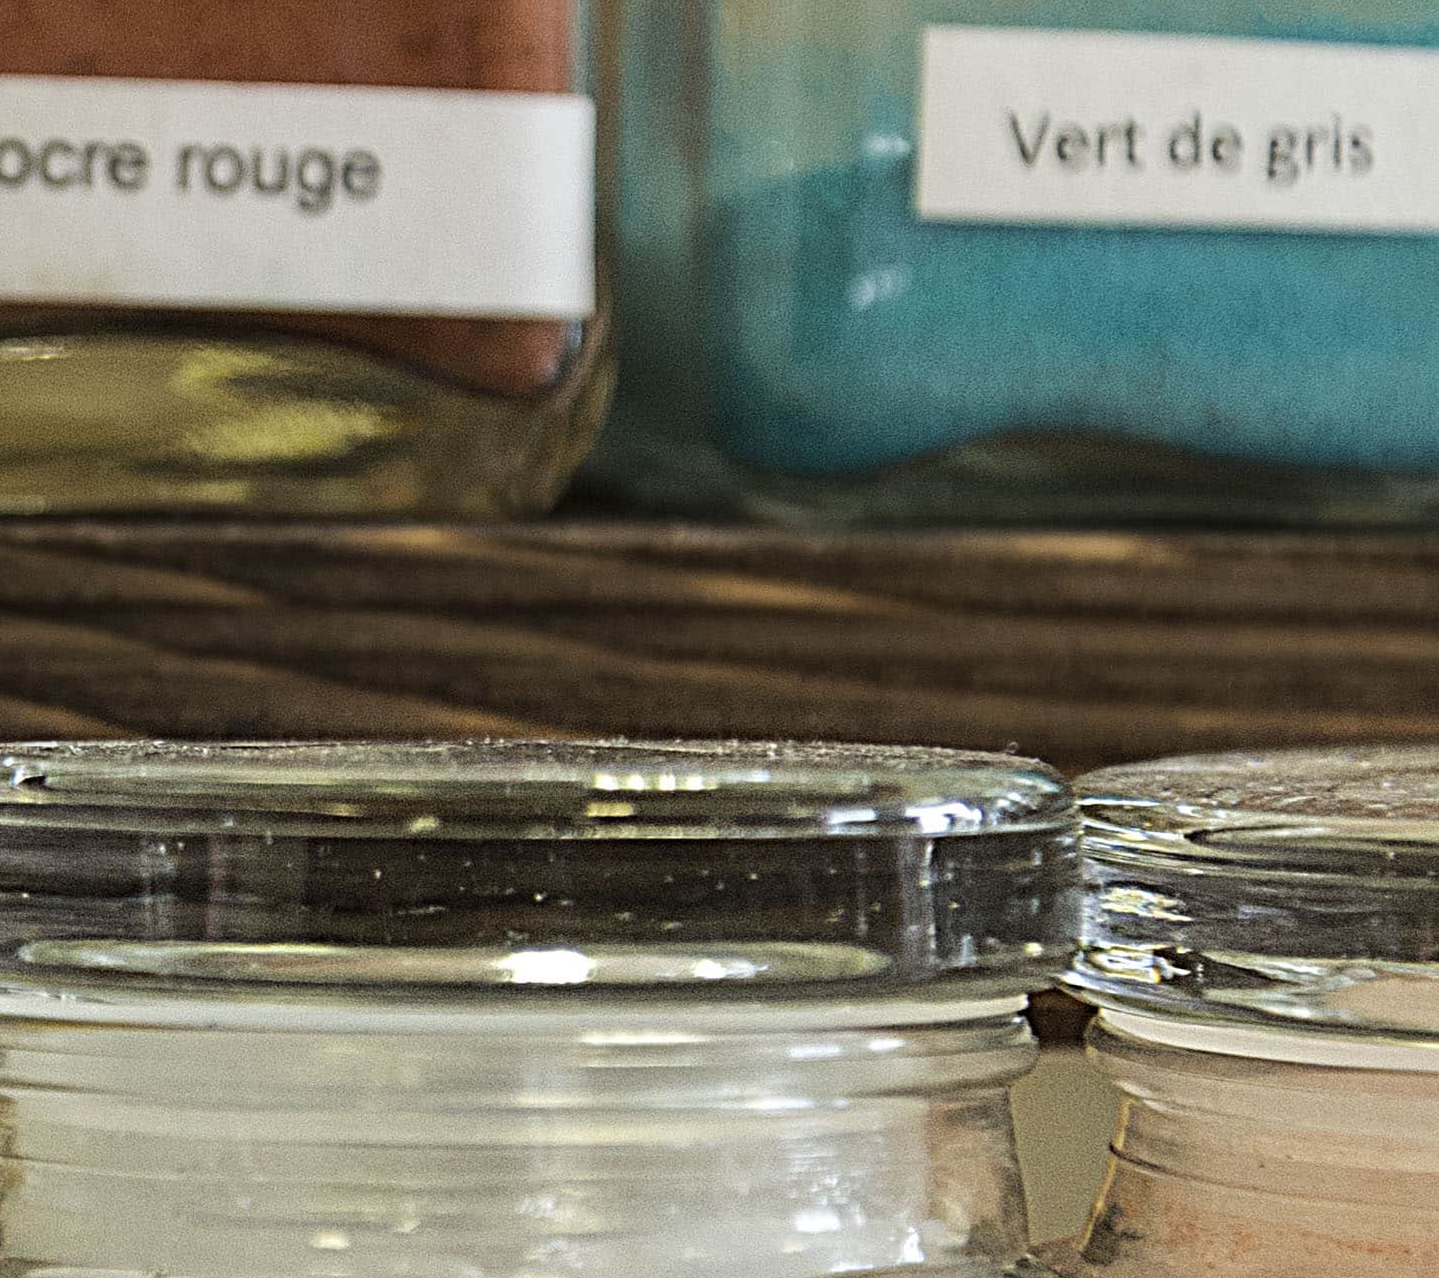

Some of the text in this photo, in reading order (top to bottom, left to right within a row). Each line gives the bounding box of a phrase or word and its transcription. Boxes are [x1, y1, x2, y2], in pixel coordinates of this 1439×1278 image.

[176, 138, 384, 214] rouge
[1007, 109, 1375, 184] Vert de gris
